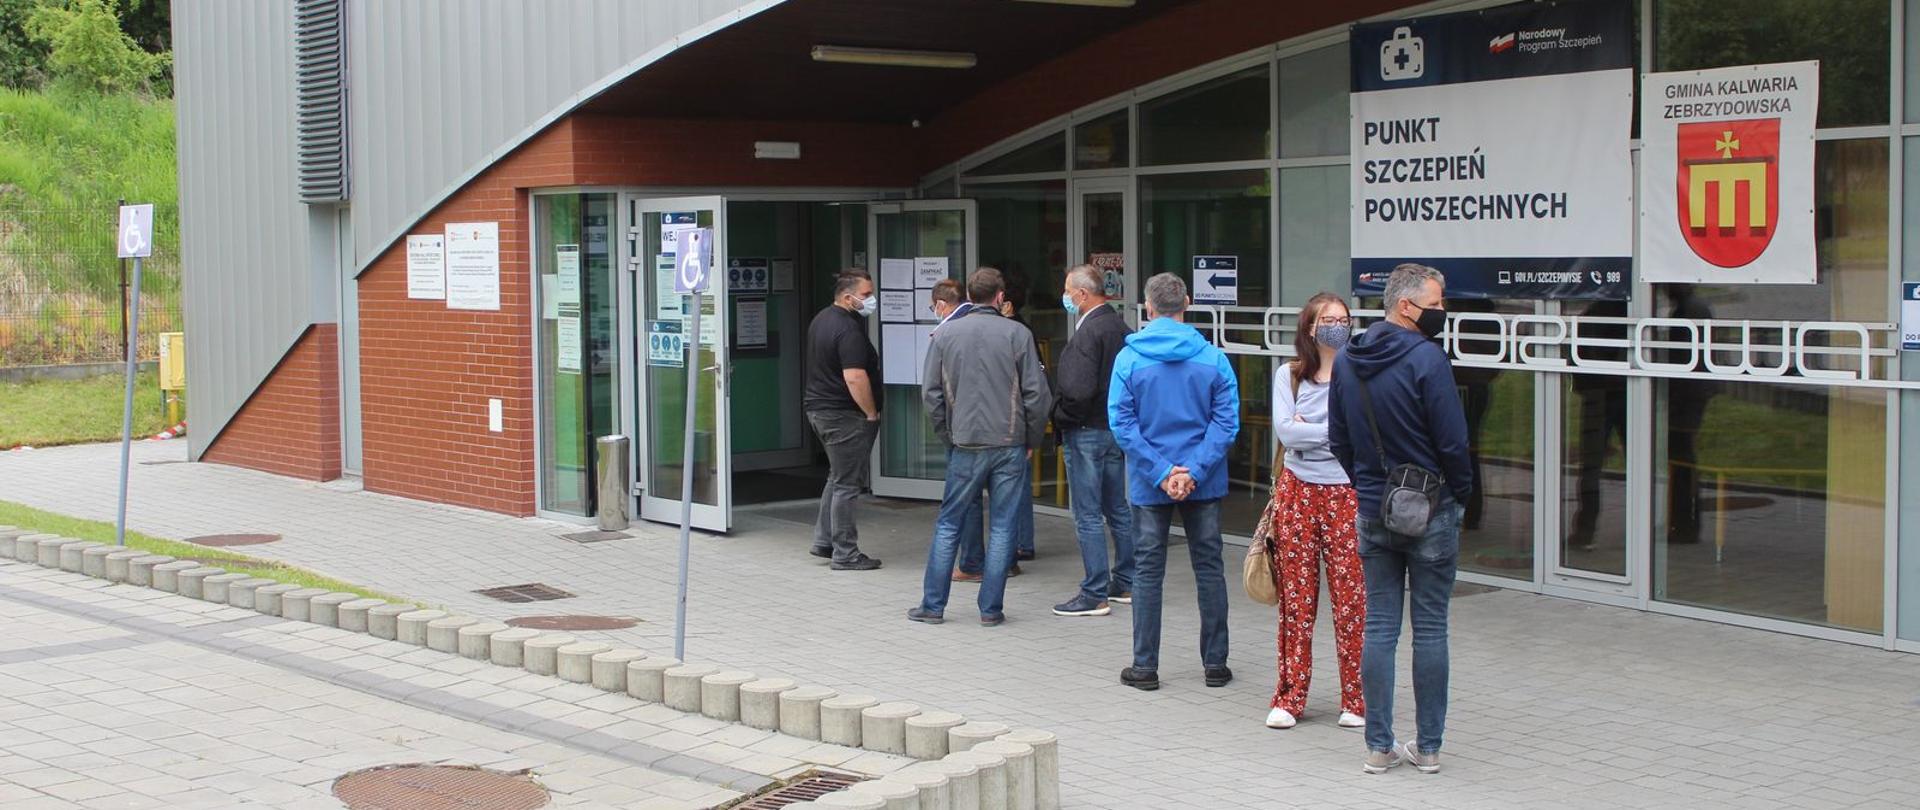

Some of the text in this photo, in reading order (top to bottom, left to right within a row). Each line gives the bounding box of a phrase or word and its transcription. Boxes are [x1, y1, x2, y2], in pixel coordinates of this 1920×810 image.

[1518, 28, 1566, 40] Narodowy
[1518, 34, 1602, 53] Program Szczepień
[1665, 76, 1798, 99] GMINA KALWARIA
[1663, 98, 1792, 119] ZEBRZYDOWSKA
[1364, 117, 1440, 145] PUNKT
[1364, 146, 1485, 184] SZCZEPIEŃ
[1365, 192, 1567, 222] POWSZECHNYCH
[1606, 271, 1621, 283] 989
